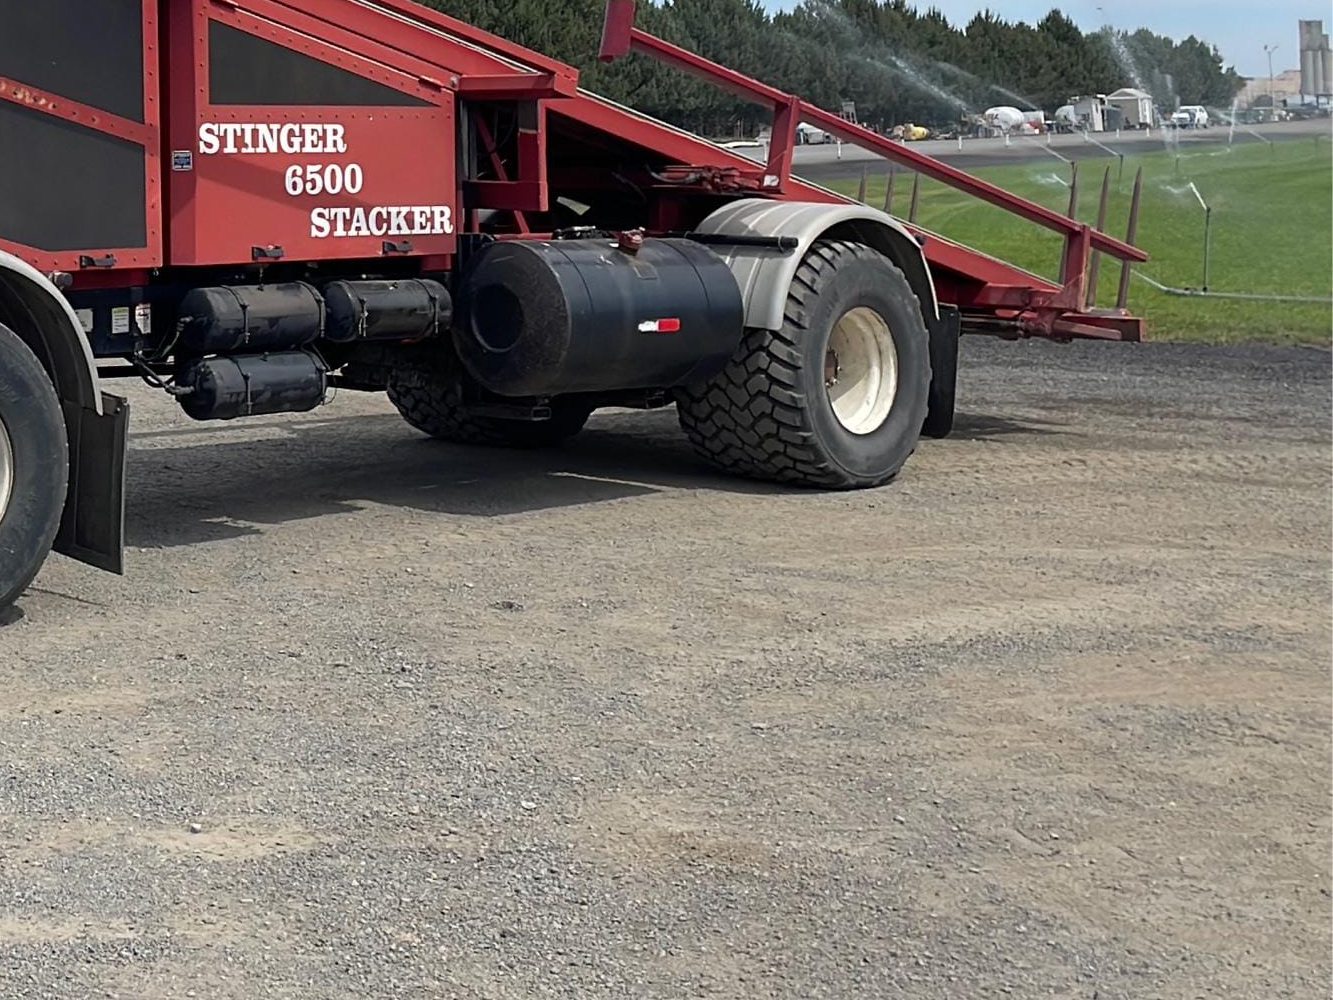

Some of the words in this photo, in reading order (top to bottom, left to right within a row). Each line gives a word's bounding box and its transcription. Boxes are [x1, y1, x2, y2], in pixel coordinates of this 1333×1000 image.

[198, 122, 347, 154] STINGER
[284, 163, 363, 196] 6500
[310, 205, 454, 238] STACKER
